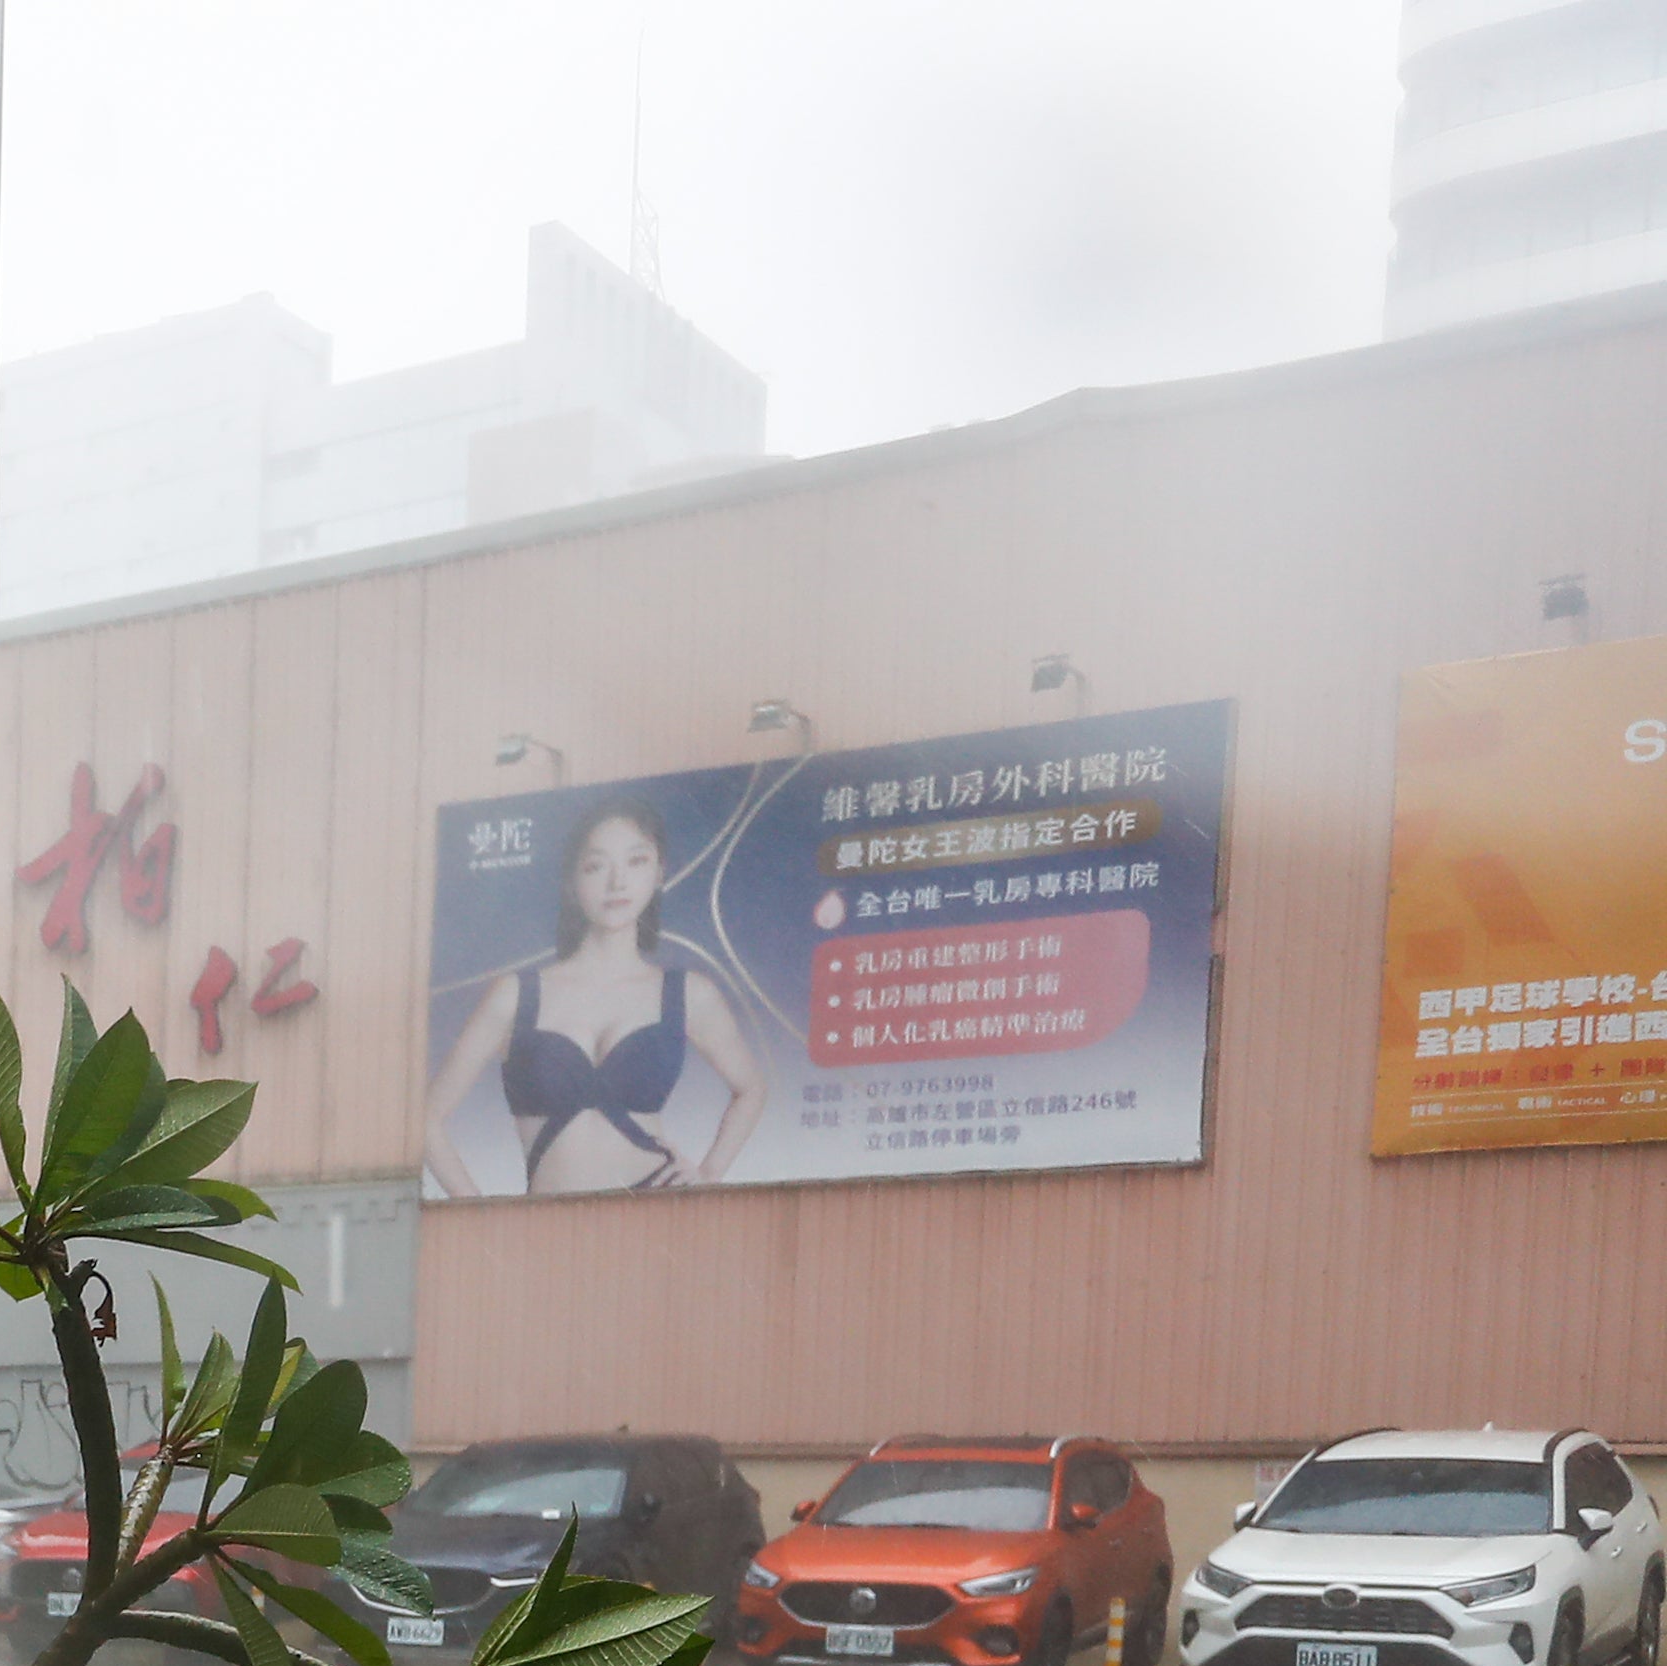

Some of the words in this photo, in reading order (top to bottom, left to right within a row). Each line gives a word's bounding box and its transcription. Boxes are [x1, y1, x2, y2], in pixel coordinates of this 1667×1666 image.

[836, 808, 1137, 870] 曼陀女王波指定合作
[856, 861, 1160, 918] 全台唯一乳房專科醫院
[854, 933, 1063, 975] 乳房重建整形手術
[852, 1008, 1087, 1049] 個人化乳癌精準治療
